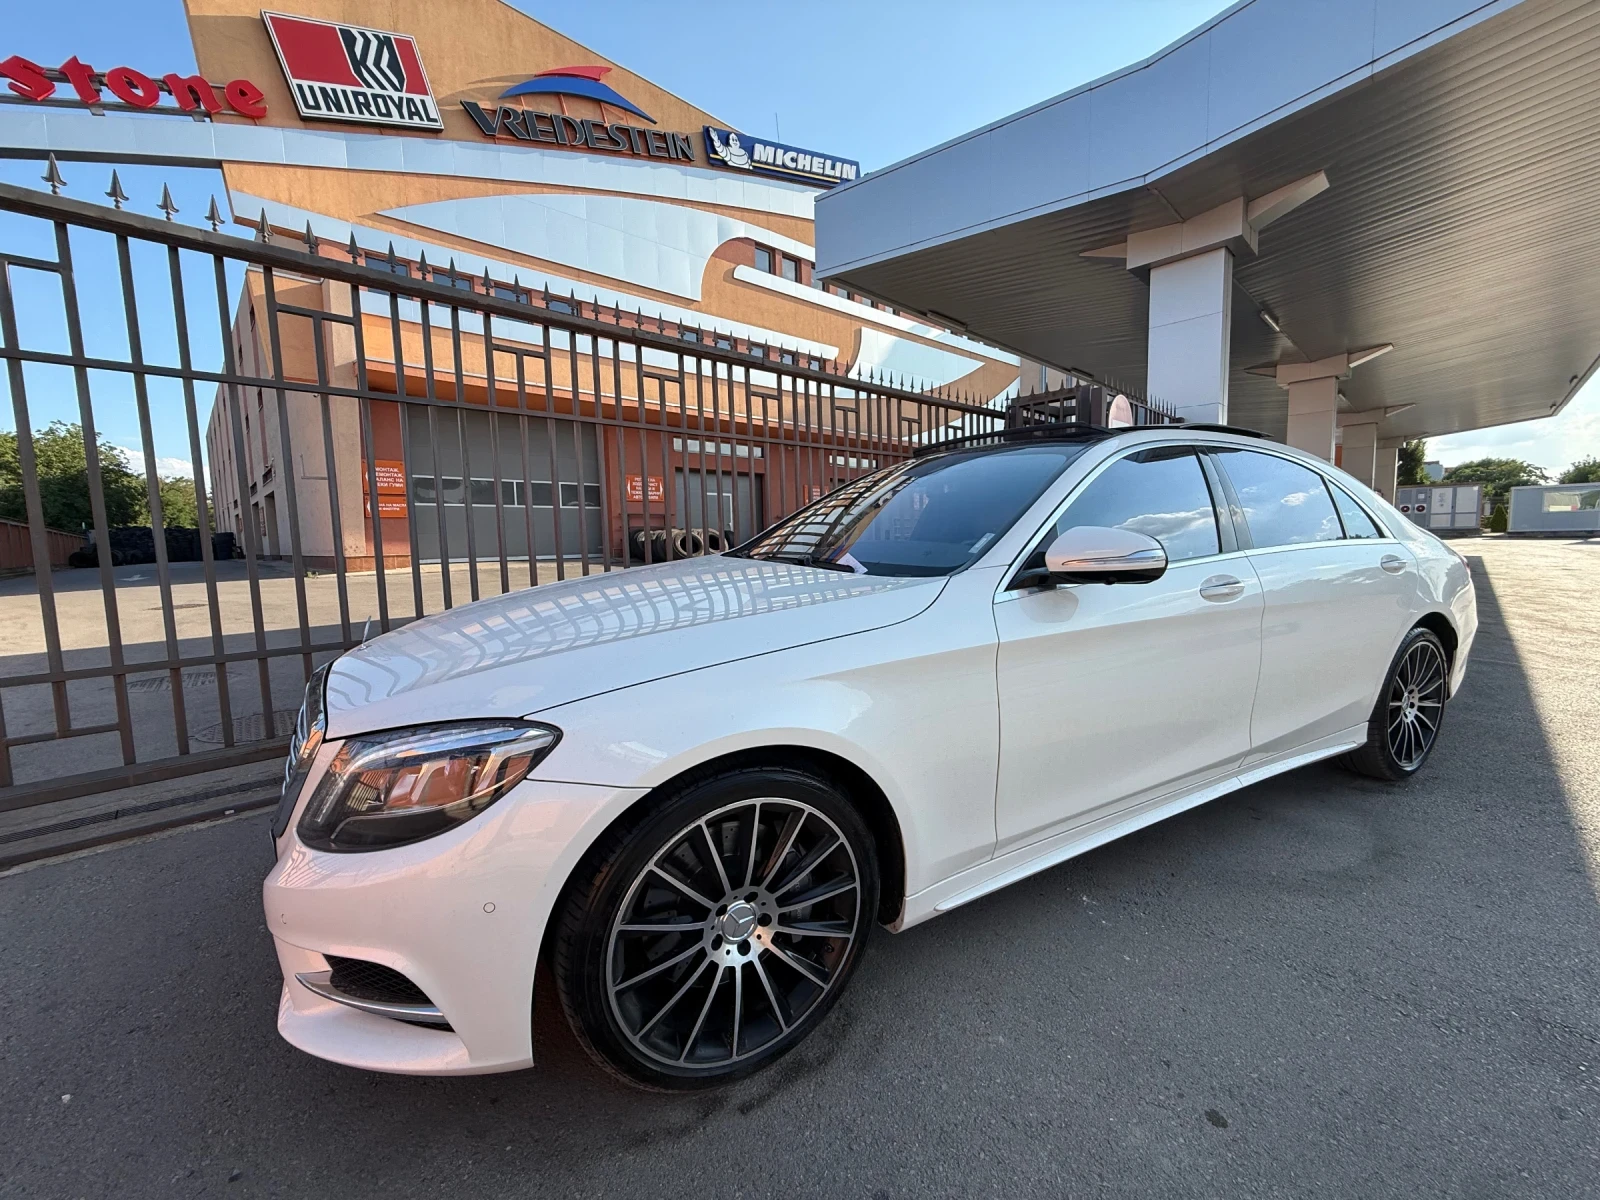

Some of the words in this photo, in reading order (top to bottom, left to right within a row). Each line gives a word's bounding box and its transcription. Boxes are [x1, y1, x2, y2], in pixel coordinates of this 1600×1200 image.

[0, 55, 268, 119] stone
[296, 83, 439, 123] UNIROYAL
[460, 99, 696, 162] VREDESTEIN
[753, 143, 857, 181] MICHELIN
